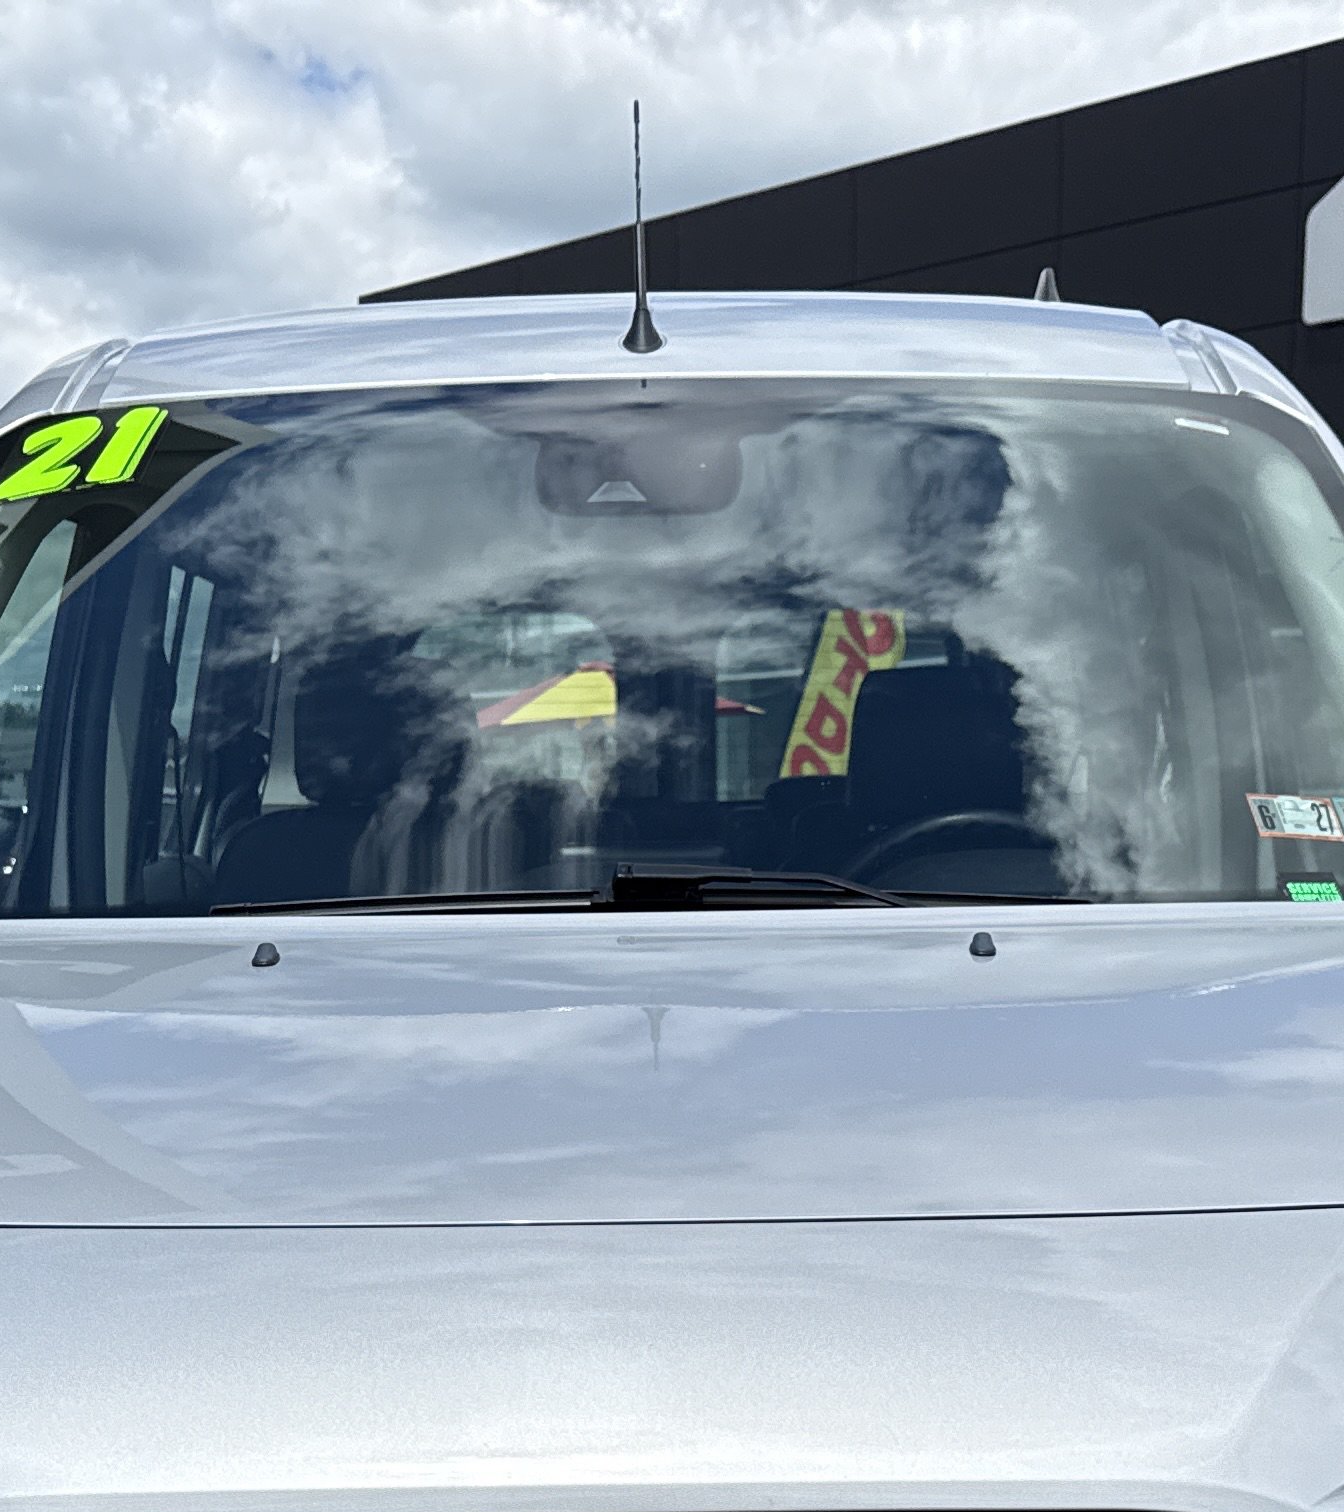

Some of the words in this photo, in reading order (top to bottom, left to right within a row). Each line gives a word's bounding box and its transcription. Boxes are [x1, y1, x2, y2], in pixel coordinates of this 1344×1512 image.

[1258, 804, 1276, 830] 6
[1309, 802, 1334, 835] 27
[1286, 882, 1338, 894] SERVICE
